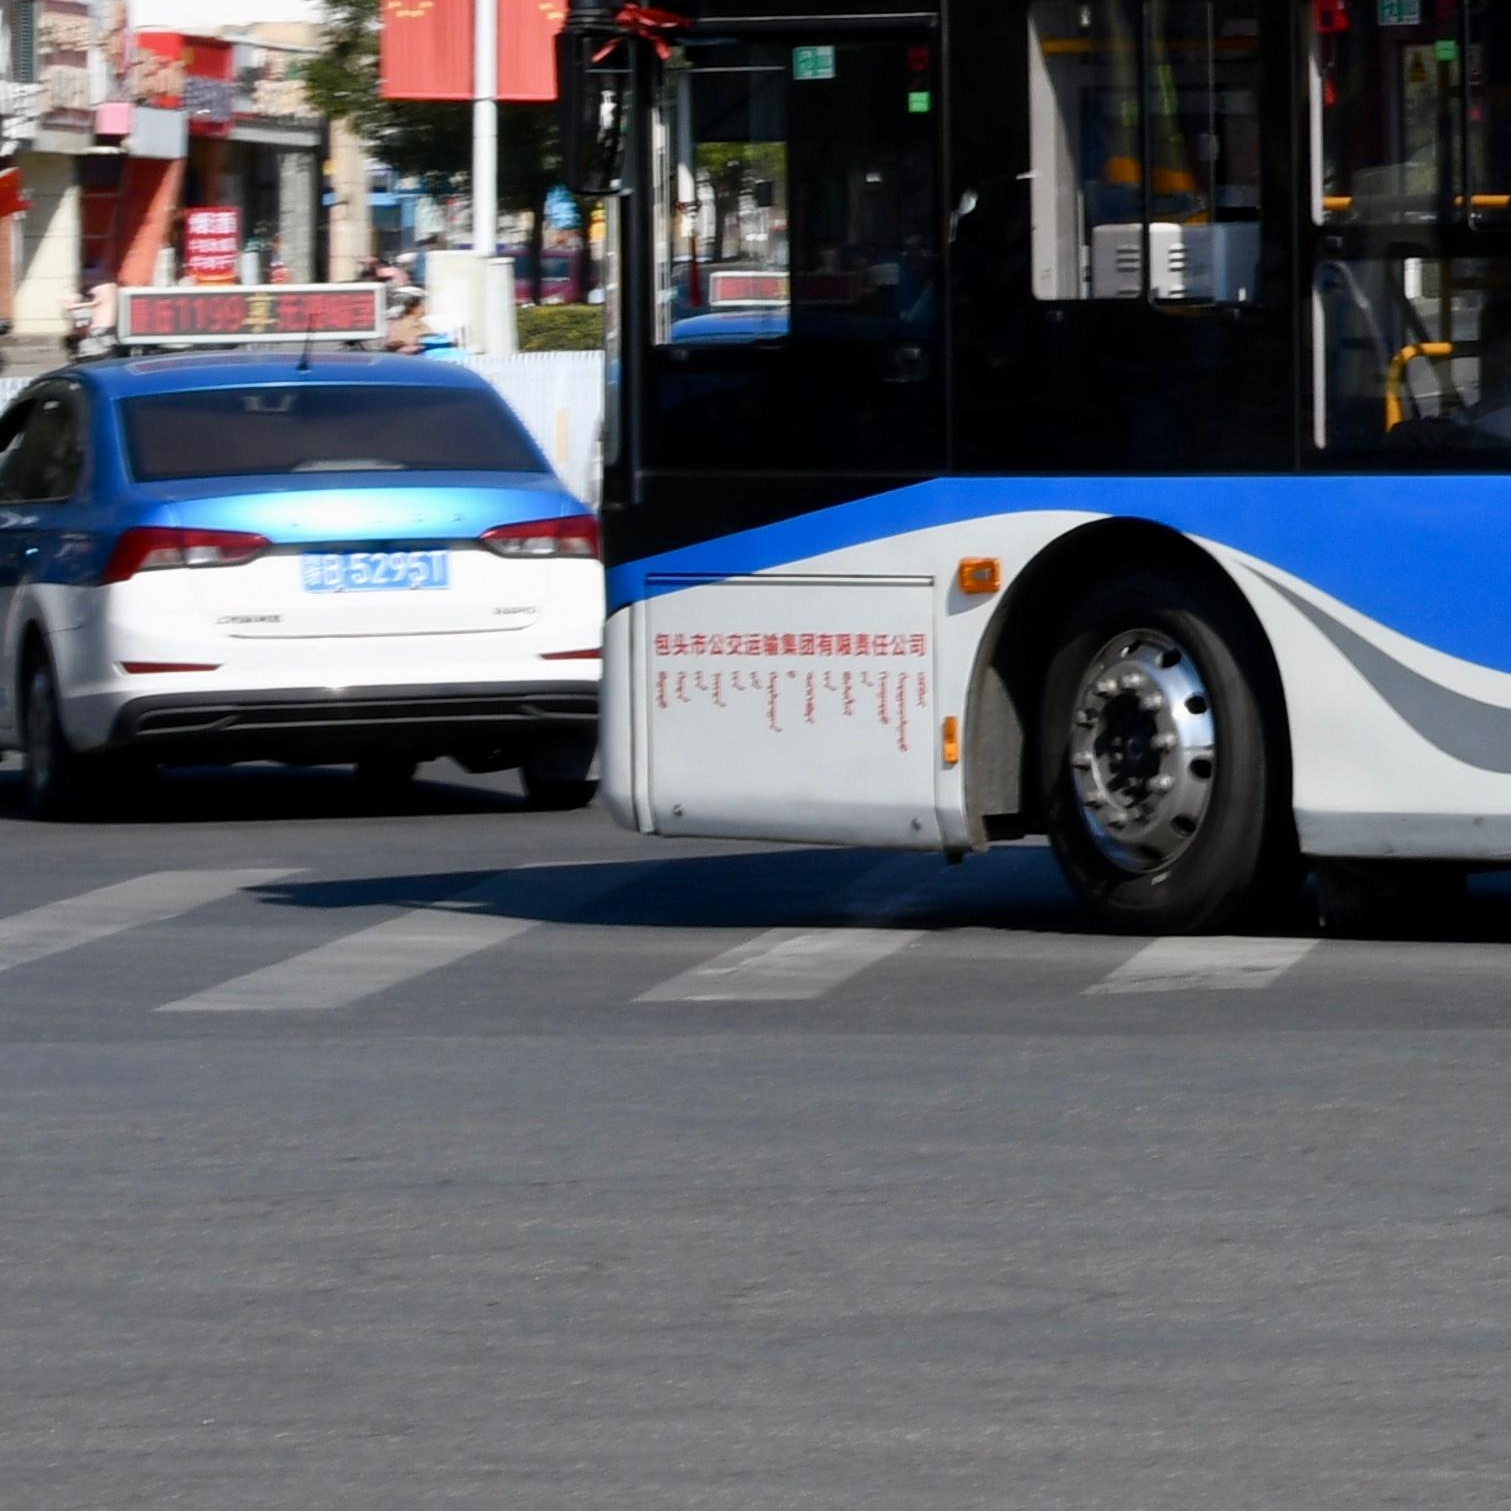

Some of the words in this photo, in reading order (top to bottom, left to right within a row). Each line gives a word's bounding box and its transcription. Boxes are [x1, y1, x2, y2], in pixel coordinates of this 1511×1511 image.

[655, 633, 926, 657] 包头市公交运输集团有限责任公司
